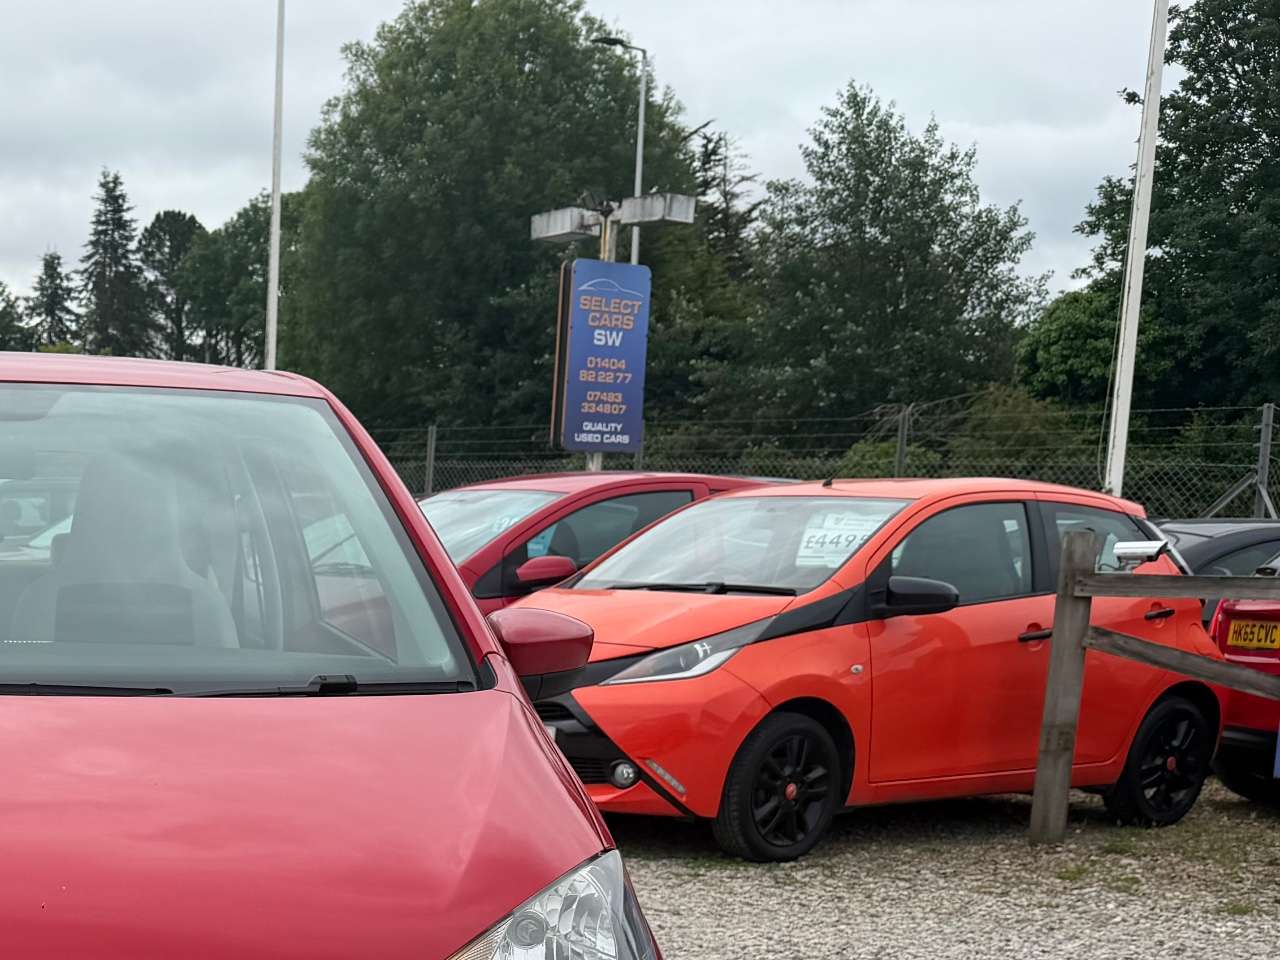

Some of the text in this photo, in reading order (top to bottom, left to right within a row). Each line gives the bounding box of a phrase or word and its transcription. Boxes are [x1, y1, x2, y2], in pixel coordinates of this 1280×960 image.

[579, 295, 643, 314] SELECT
[587, 312, 634, 330] CARS
[592, 330, 623, 346] SW
[586, 356, 626, 369] 01404
[582, 421, 623, 432] QUALITY
[574, 432, 630, 445] USED CARS
[1231, 623, 1256, 643] HK65
